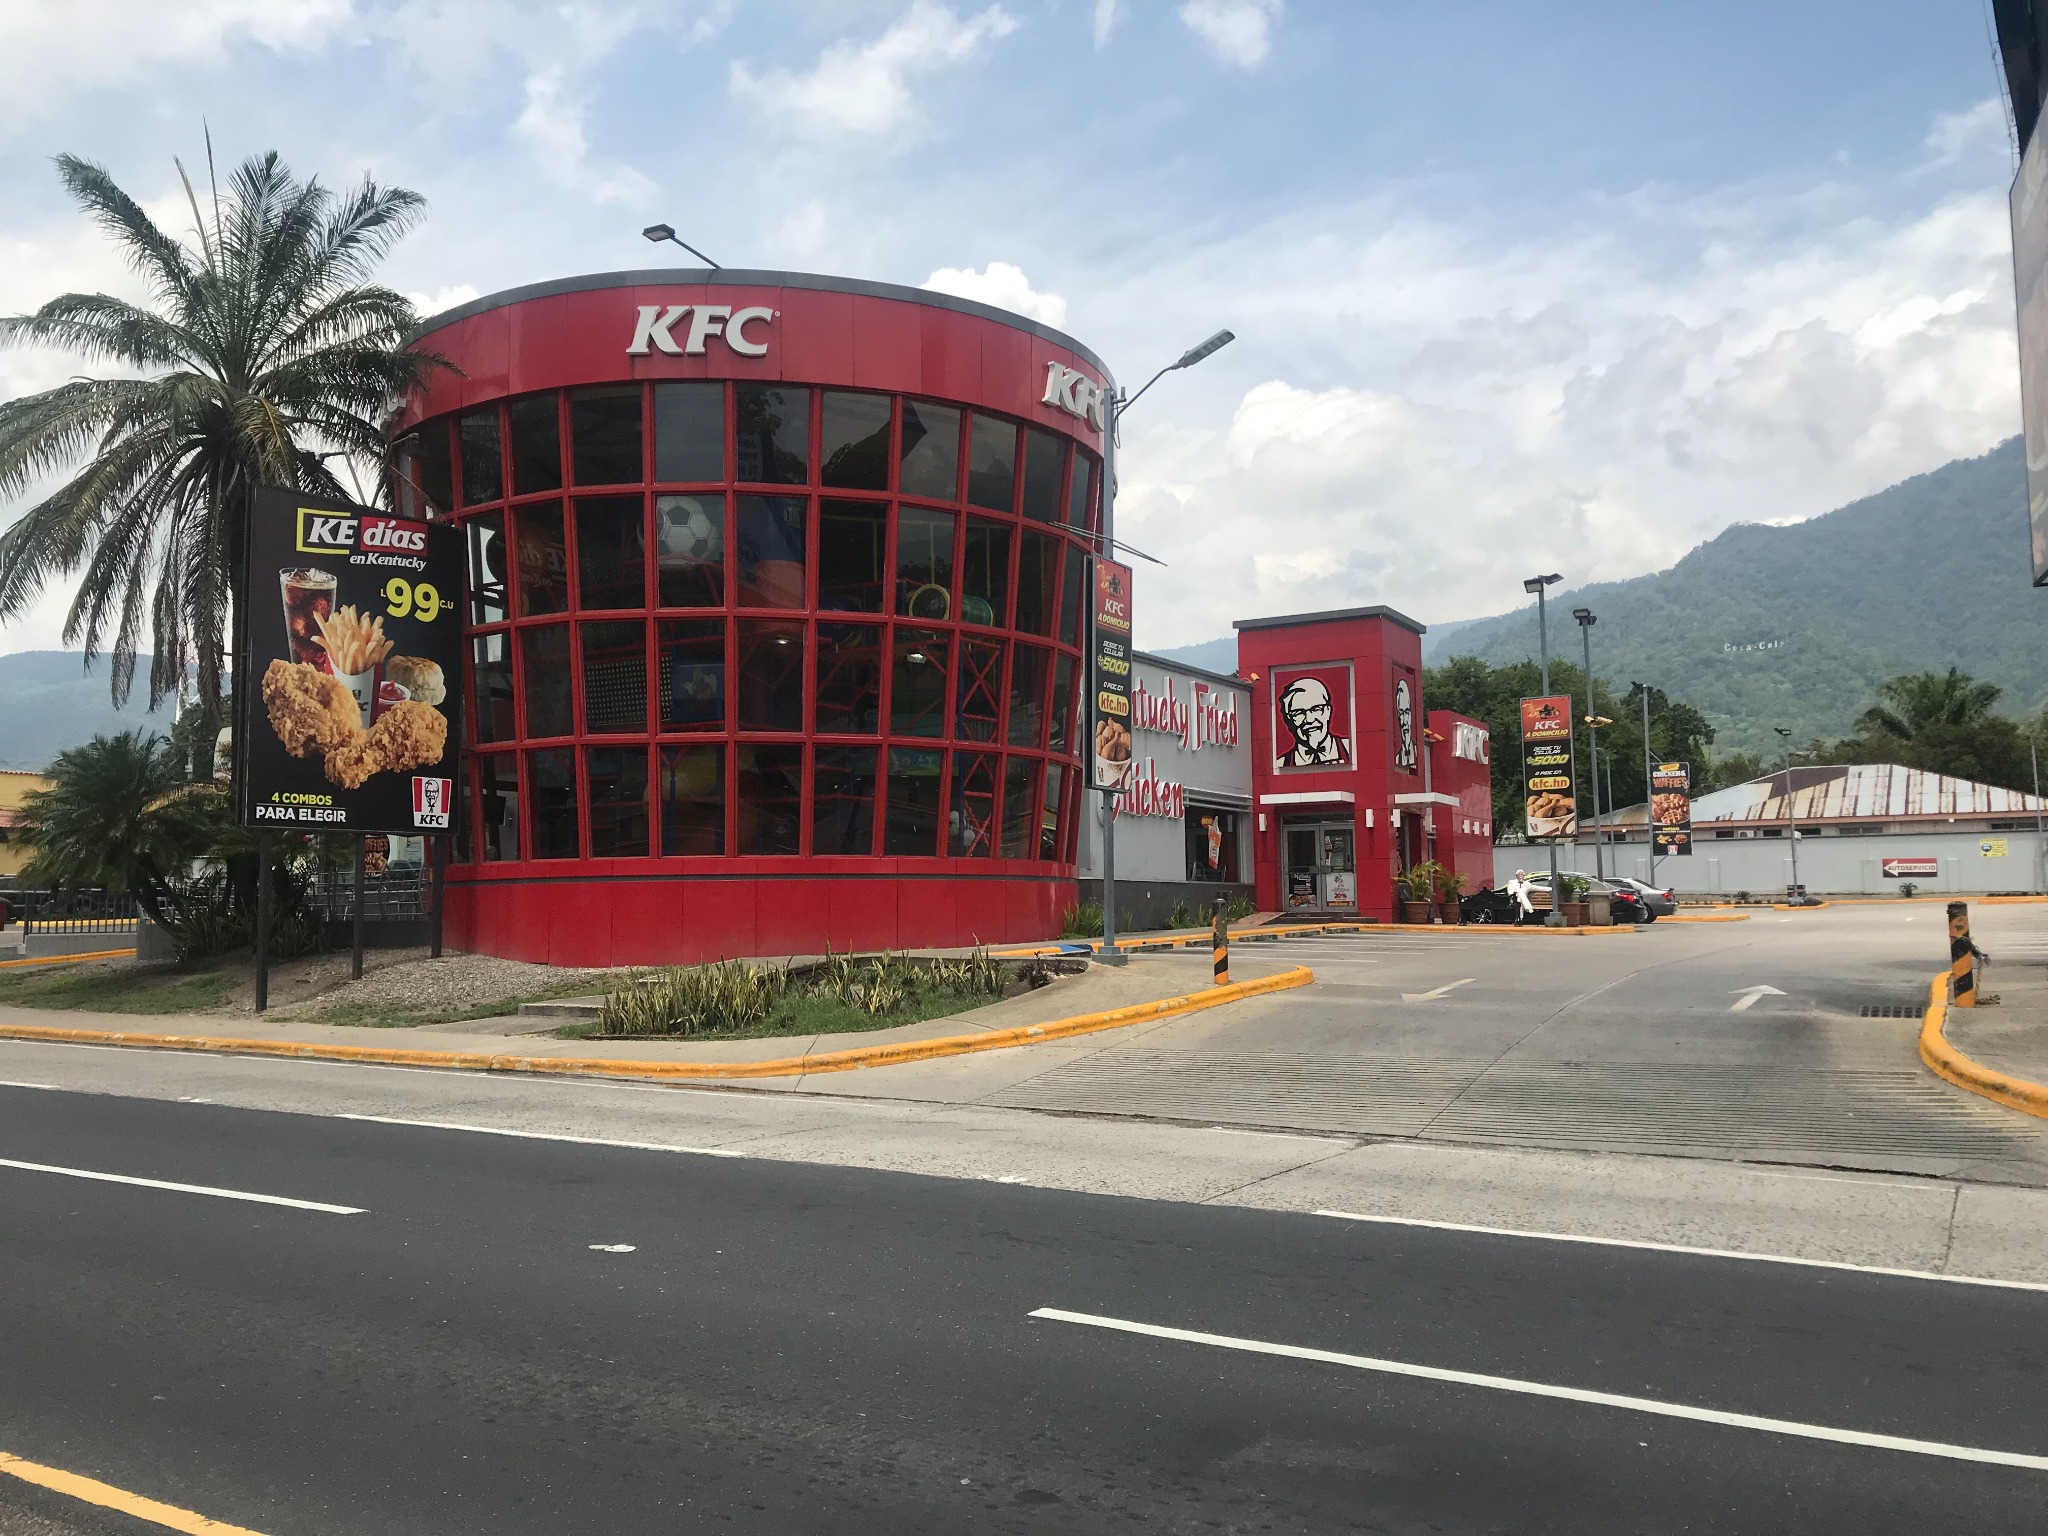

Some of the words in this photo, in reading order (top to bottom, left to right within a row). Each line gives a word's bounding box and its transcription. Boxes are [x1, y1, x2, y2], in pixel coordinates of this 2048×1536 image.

[626, 305, 774, 357] KFC
[307, 517, 359, 545] KE
[363, 520, 426, 550] días
[350, 555, 365, 565] en
[366, 553, 427, 571] Kentucky
[386, 577, 439, 623] 99
[1105, 599, 1124, 617] KFC
[1098, 613, 1103, 622] A
[1103, 614, 1130, 630] DOMICILIO
[1101, 694, 1127, 714] kfc.hn
[1131, 676, 1190, 751] tucky
[1190, 681, 1238, 751] Fried
[1532, 729, 1569, 737] DOMICILIO
[1534, 720, 1561, 730] KFC
[1451, 722, 1489, 764] KFC
[1113, 757, 1185, 823] icken
[1532, 778, 1568, 788] kfc.hn
[271, 792, 280, 803] 4
[282, 793, 333, 806] COMBOS
[255, 806, 296, 820] PARA
[299, 808, 347, 823] ELEGIR
[419, 814, 444, 826] KFC
[1887, 864, 1936, 872] AUTOSERVICIO
